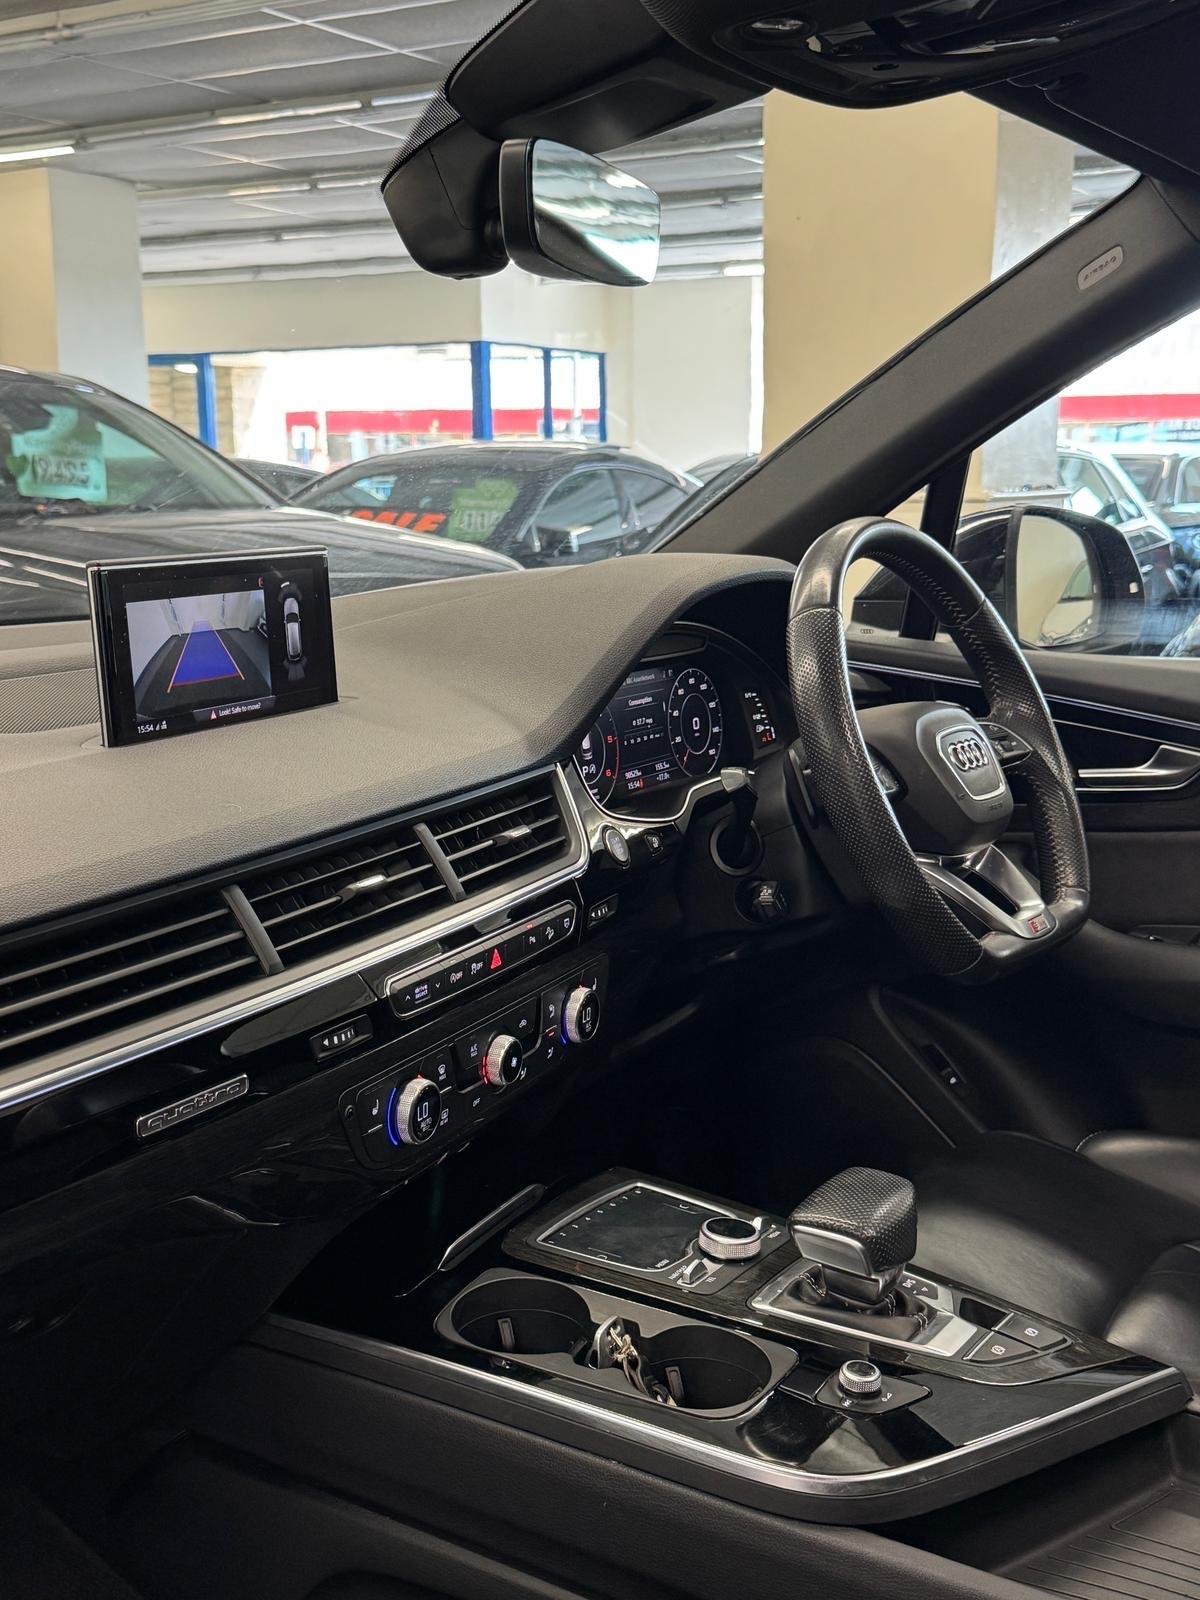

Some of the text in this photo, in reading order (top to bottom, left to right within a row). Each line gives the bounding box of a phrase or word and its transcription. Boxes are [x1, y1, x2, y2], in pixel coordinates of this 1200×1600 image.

[218, 707, 231, 716] Look!
[231, 706, 242, 714] Safe
[248, 702, 262, 711] move?
[137, 724, 154, 734] 15:54
[692, 717, 700, 730] 0
[582, 765, 589, 776] P
[606, 769, 612, 777] 6
[148, 1083, 241, 1128] quattro
